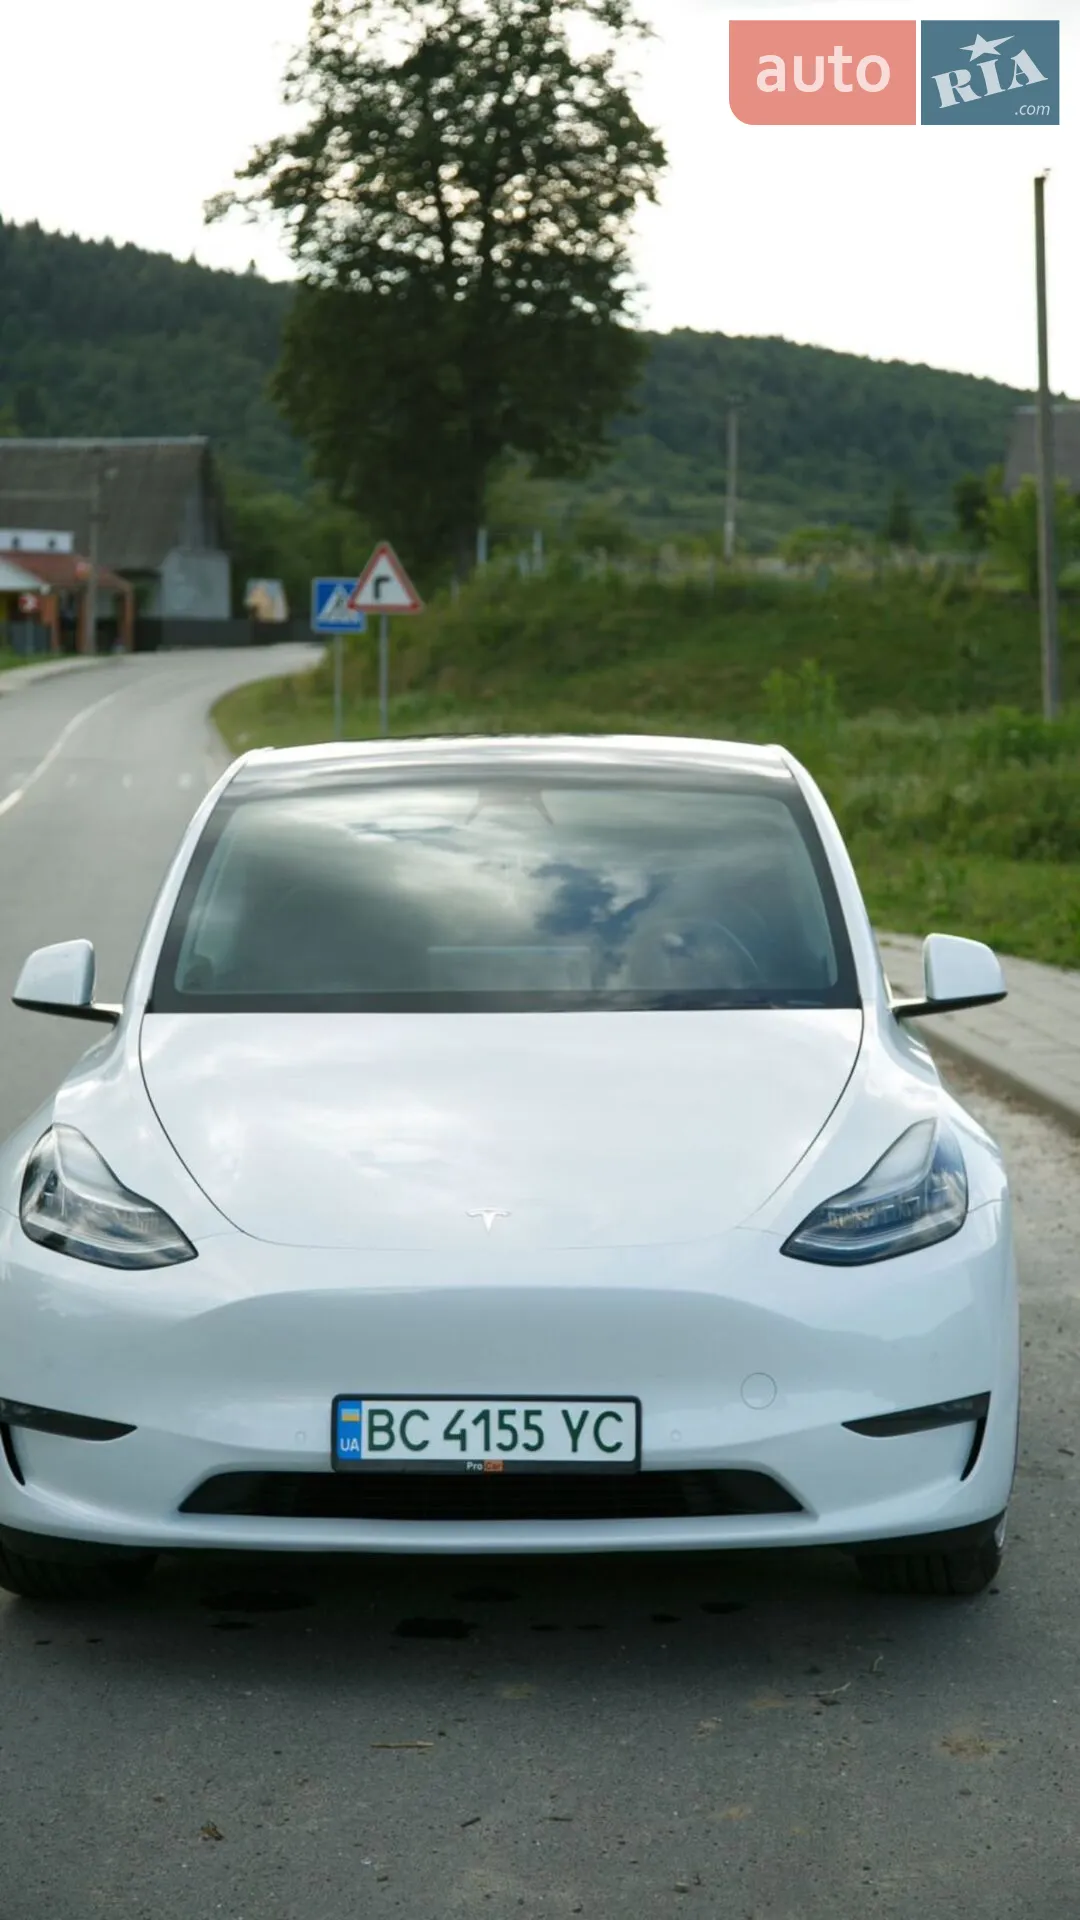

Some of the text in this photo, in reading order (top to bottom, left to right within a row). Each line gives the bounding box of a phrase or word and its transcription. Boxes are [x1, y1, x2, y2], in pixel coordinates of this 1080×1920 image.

[340, 1438, 360, 1451] UA
[367, 1408, 624, 1453] BC 4155 YC
